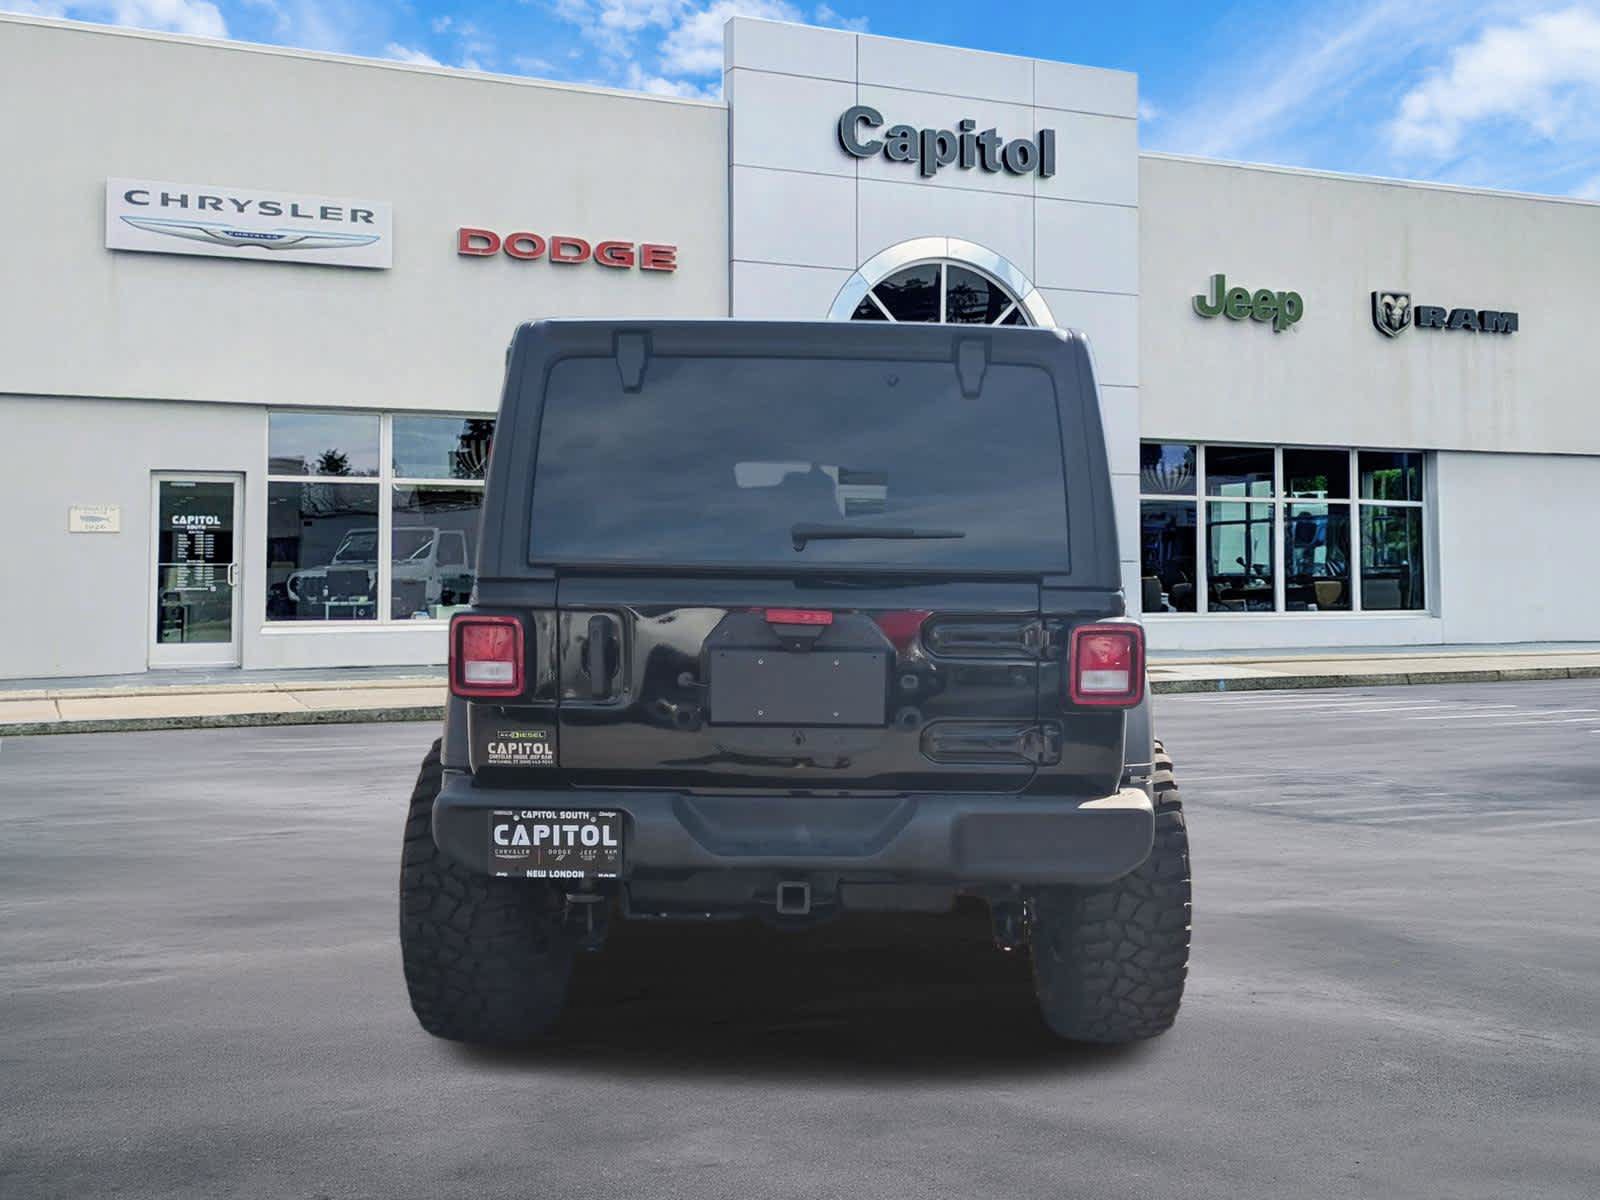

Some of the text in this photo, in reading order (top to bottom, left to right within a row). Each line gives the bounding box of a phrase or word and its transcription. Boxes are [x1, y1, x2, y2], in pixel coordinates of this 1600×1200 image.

[838, 105, 1056, 178] Capitol
[124, 190, 375, 224] CHRYSLER
[458, 227, 678, 272] DODGE
[1192, 274, 1304, 333] Jeep
[1413, 304, 1520, 334] RAM
[171, 515, 221, 525] CAPITOL
[487, 742, 553, 754] CAPITOL
[521, 810, 557, 819] CAPITOL
[559, 810, 590, 819] SOUTH
[493, 824, 618, 846] CAPITOL
[526, 869, 585, 878] NEW LONDON
